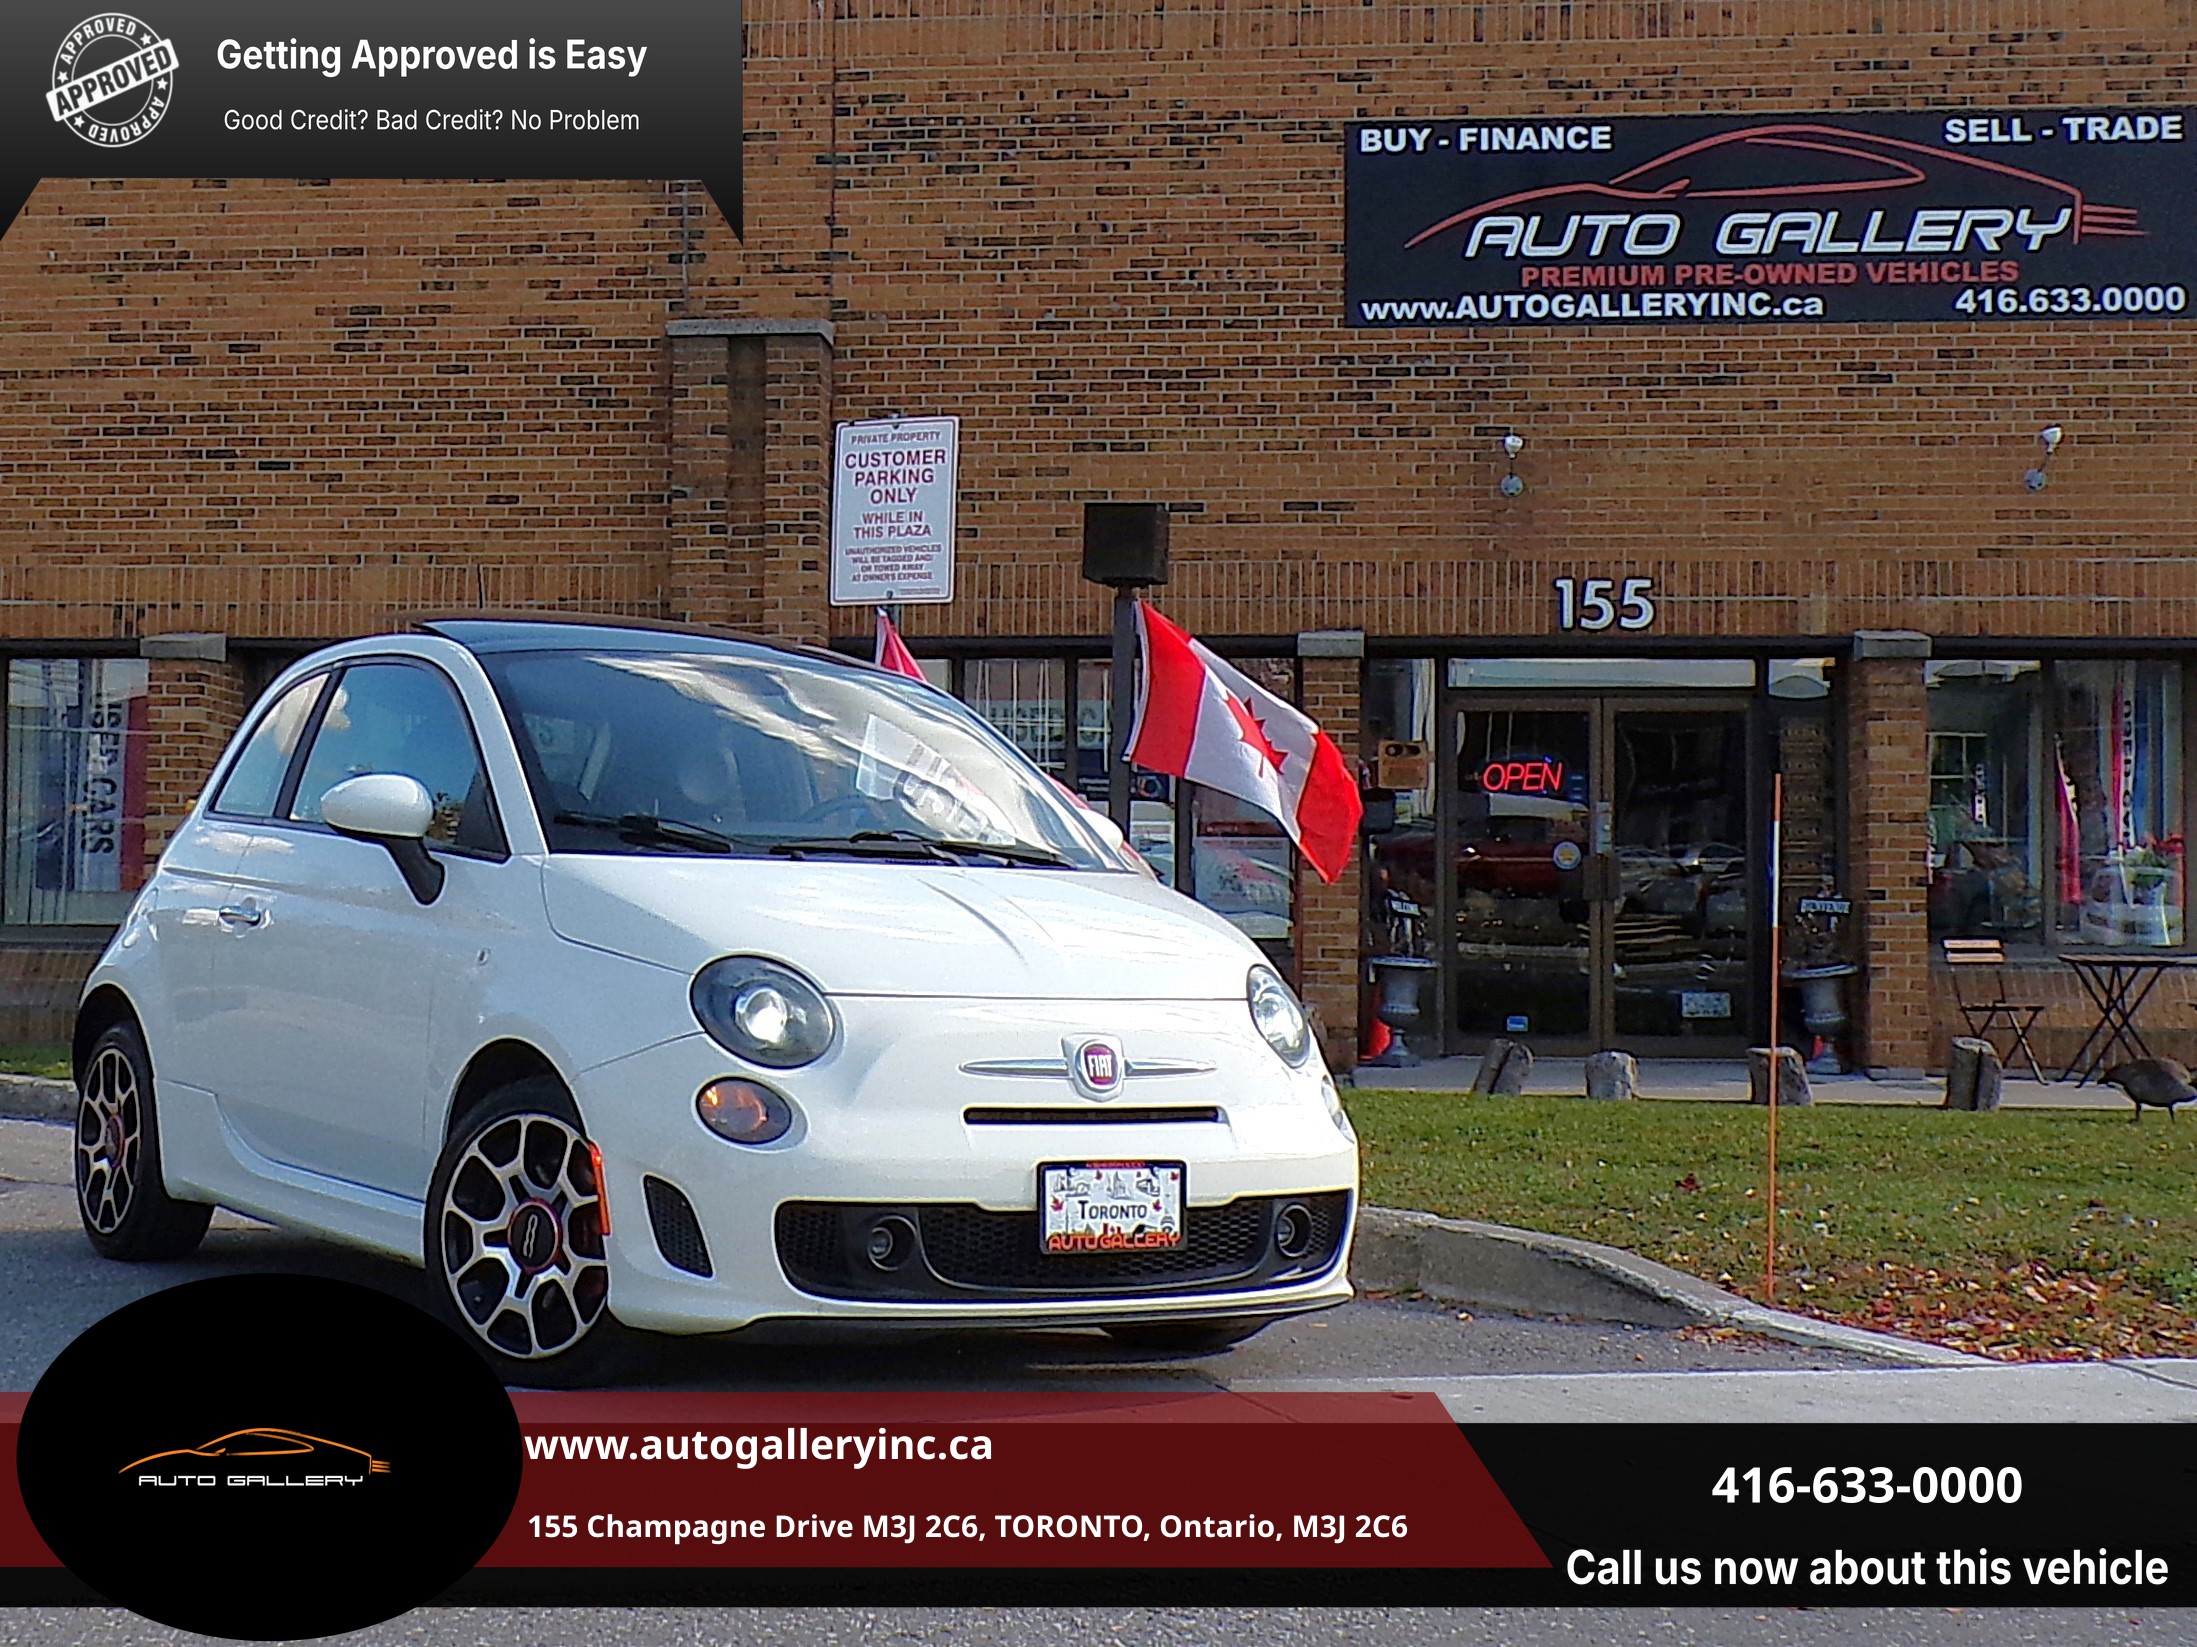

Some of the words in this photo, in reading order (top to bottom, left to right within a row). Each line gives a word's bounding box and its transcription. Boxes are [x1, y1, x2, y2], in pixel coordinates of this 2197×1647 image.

[1360, 127, 1433, 153] BUY
[1458, 125, 1612, 152] FINANCE
[1943, 117, 2033, 144] SELL
[2062, 114, 2184, 142] TRADE
[1464, 212, 1682, 258] AUTO
[1715, 207, 2073, 255] GALLERY
[1521, 264, 1666, 288] PREMIUM
[1674, 262, 1859, 287] PRE-OWNED
[1865, 259, 2020, 284] VEHICLES
[1361, 291, 1824, 321] www.AUTOGALLERYINC.ca
[1954, 285, 2187, 315] 416.633.0000
[851, 433, 889, 444] PRIVATE
[891, 431, 941, 442] PROPERTY
[844, 448, 946, 469] CUSTOMER
[854, 468, 934, 487] PARKING
[870, 487, 917, 504] ONLY
[862, 511, 905, 524] WHILE
[908, 510, 923, 522] IN
[853, 526, 884, 539] THIS
[887, 524, 932, 538] PLAZA
[903, 544, 942, 553] VEHICLES
[852, 556, 868, 564] WILL
[851, 574, 861, 582] AT
[1553, 577, 1655, 630] 155
[1483, 762, 1563, 791] OPEN
[1087, 1053, 1115, 1079] FIAT
[1049, 1235, 1098, 1250] AUTO
[1100, 1231, 1181, 1248] GALLERY
